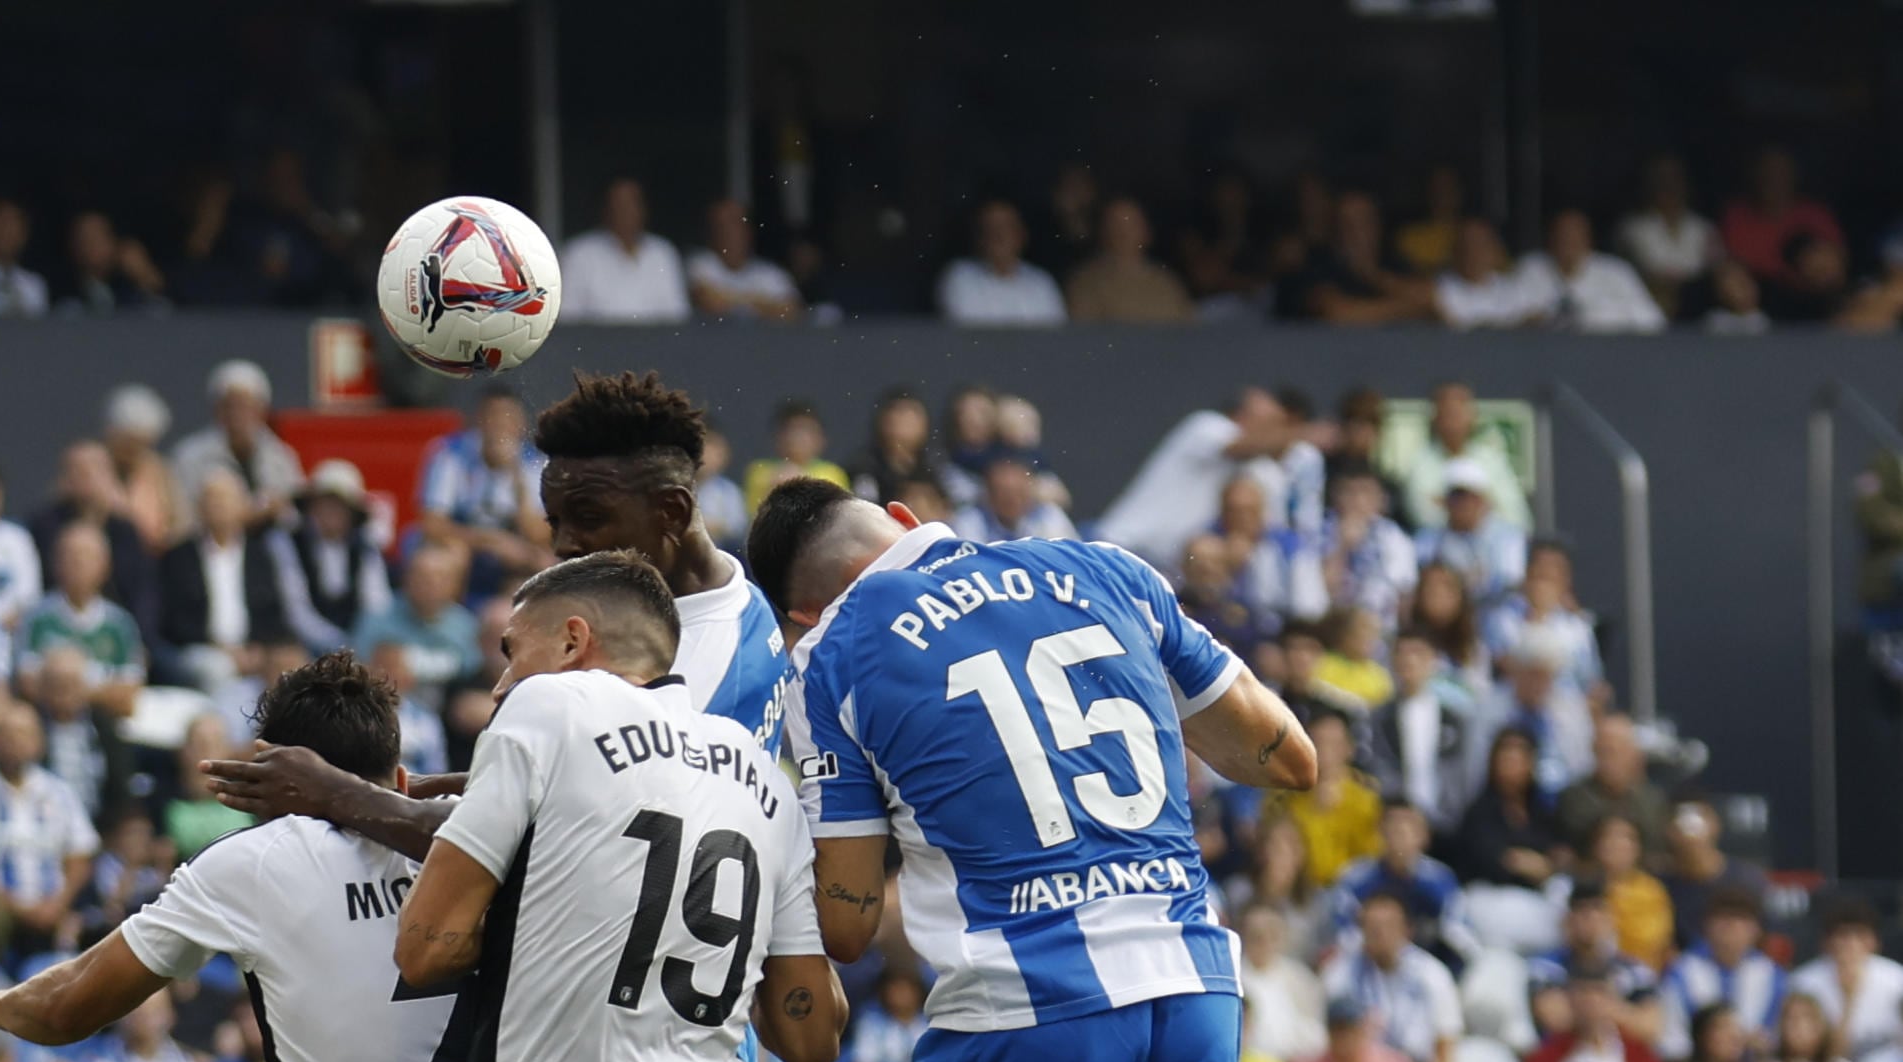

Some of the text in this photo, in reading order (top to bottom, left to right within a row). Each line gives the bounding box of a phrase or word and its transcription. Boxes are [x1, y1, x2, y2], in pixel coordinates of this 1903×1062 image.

[408, 267, 417, 302] LALIGA
[890, 568, 1090, 650] PABLO V.
[594, 720, 675, 775] EDU
[946, 623, 1167, 848] 15
[607, 808, 760, 1027] 19
